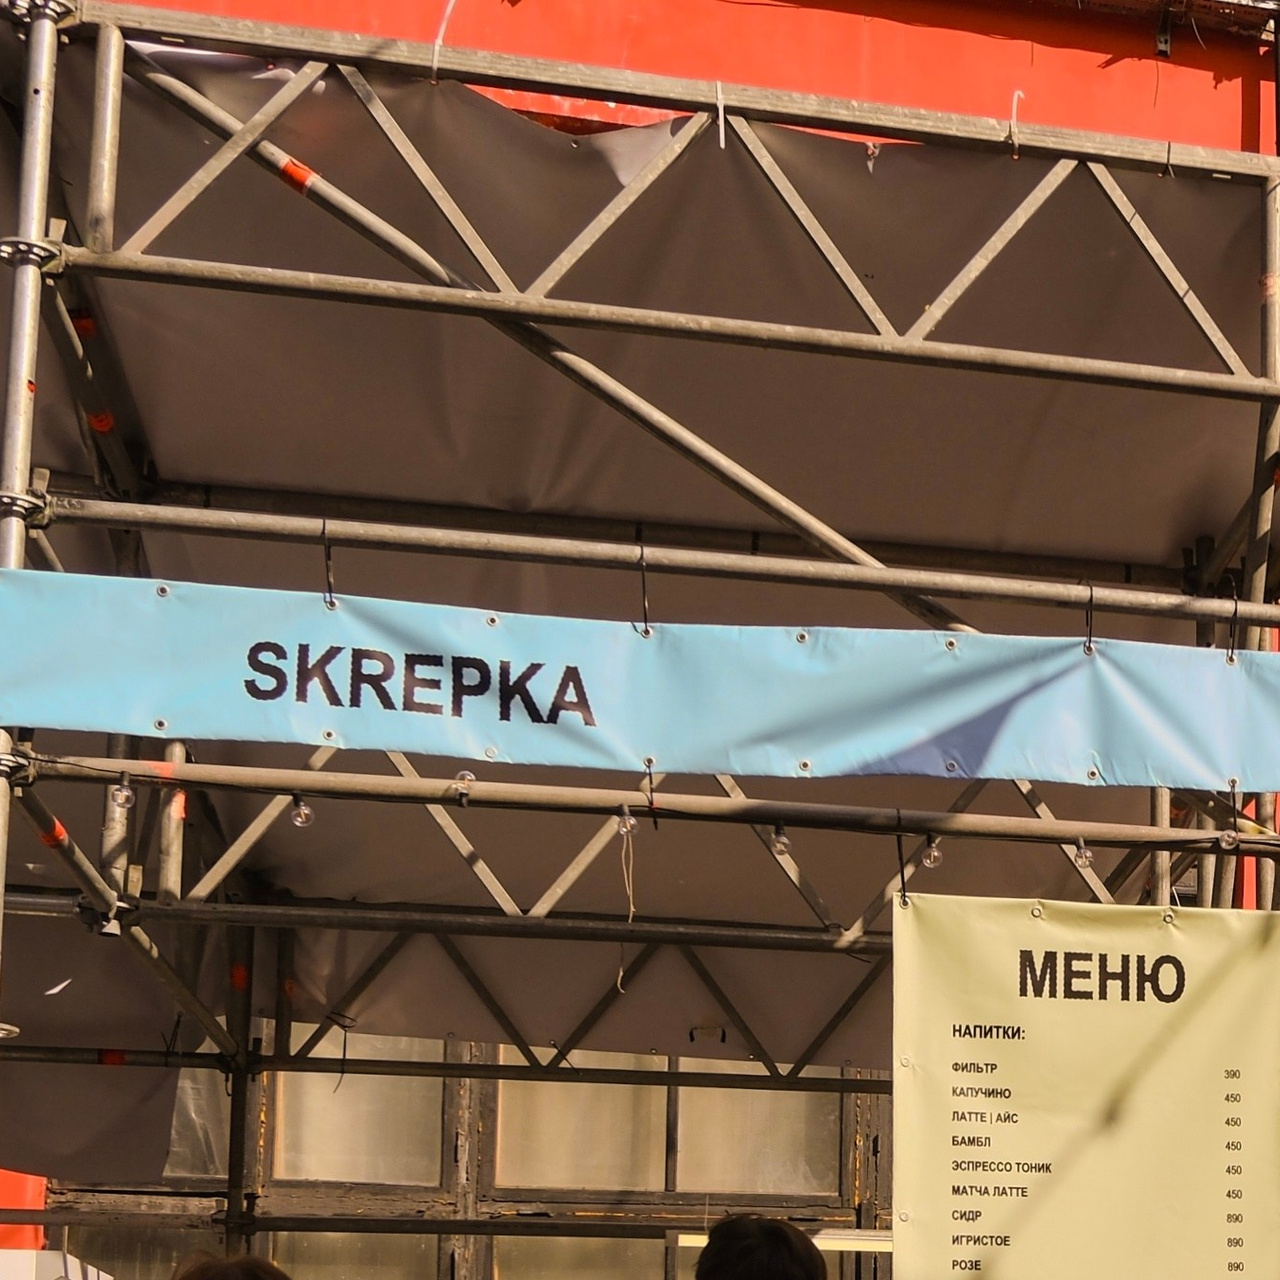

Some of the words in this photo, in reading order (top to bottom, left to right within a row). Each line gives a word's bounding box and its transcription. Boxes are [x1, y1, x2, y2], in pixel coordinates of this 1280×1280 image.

[243, 640, 598, 727] SKREPKA
[1018, 948, 1187, 1004] МЕНЮ
[952, 1023, 1026, 1040] НАПИТКИ:
[951, 1061, 998, 1075] ФИЛЬТР
[1223, 1068, 1241, 1081] 390
[951, 1086, 1012, 1100] КАПУЧИНО
[1223, 1093, 1242, 1104] 450
[951, 1110, 987, 1125] ЛАТТЕ
[994, 1110, 1019, 1125] АЙС
[1224, 1116, 1242, 1128] 450
[951, 1135, 991, 1148] БАМБЛ
[1224, 1140, 1242, 1152] 450
[951, 1159, 1013, 1174] ЭСПРЕССО
[1014, 1161, 1052, 1175] ТОНИК
[1225, 1165, 1243, 1176] 450
[951, 1184, 991, 1198] МАТЧА
[992, 1185, 1029, 1199] ЛАТТЕ
[1225, 1189, 1243, 1200] 450
[951, 1209, 982, 1223] СИДР
[1225, 1213, 1244, 1224] 890
[951, 1234, 1011, 1247] ИГРИСТОЕ
[1226, 1237, 1244, 1249] 890
[951, 1258, 982, 1272] РОЗЕ
[1227, 1261, 1245, 1273] 890
